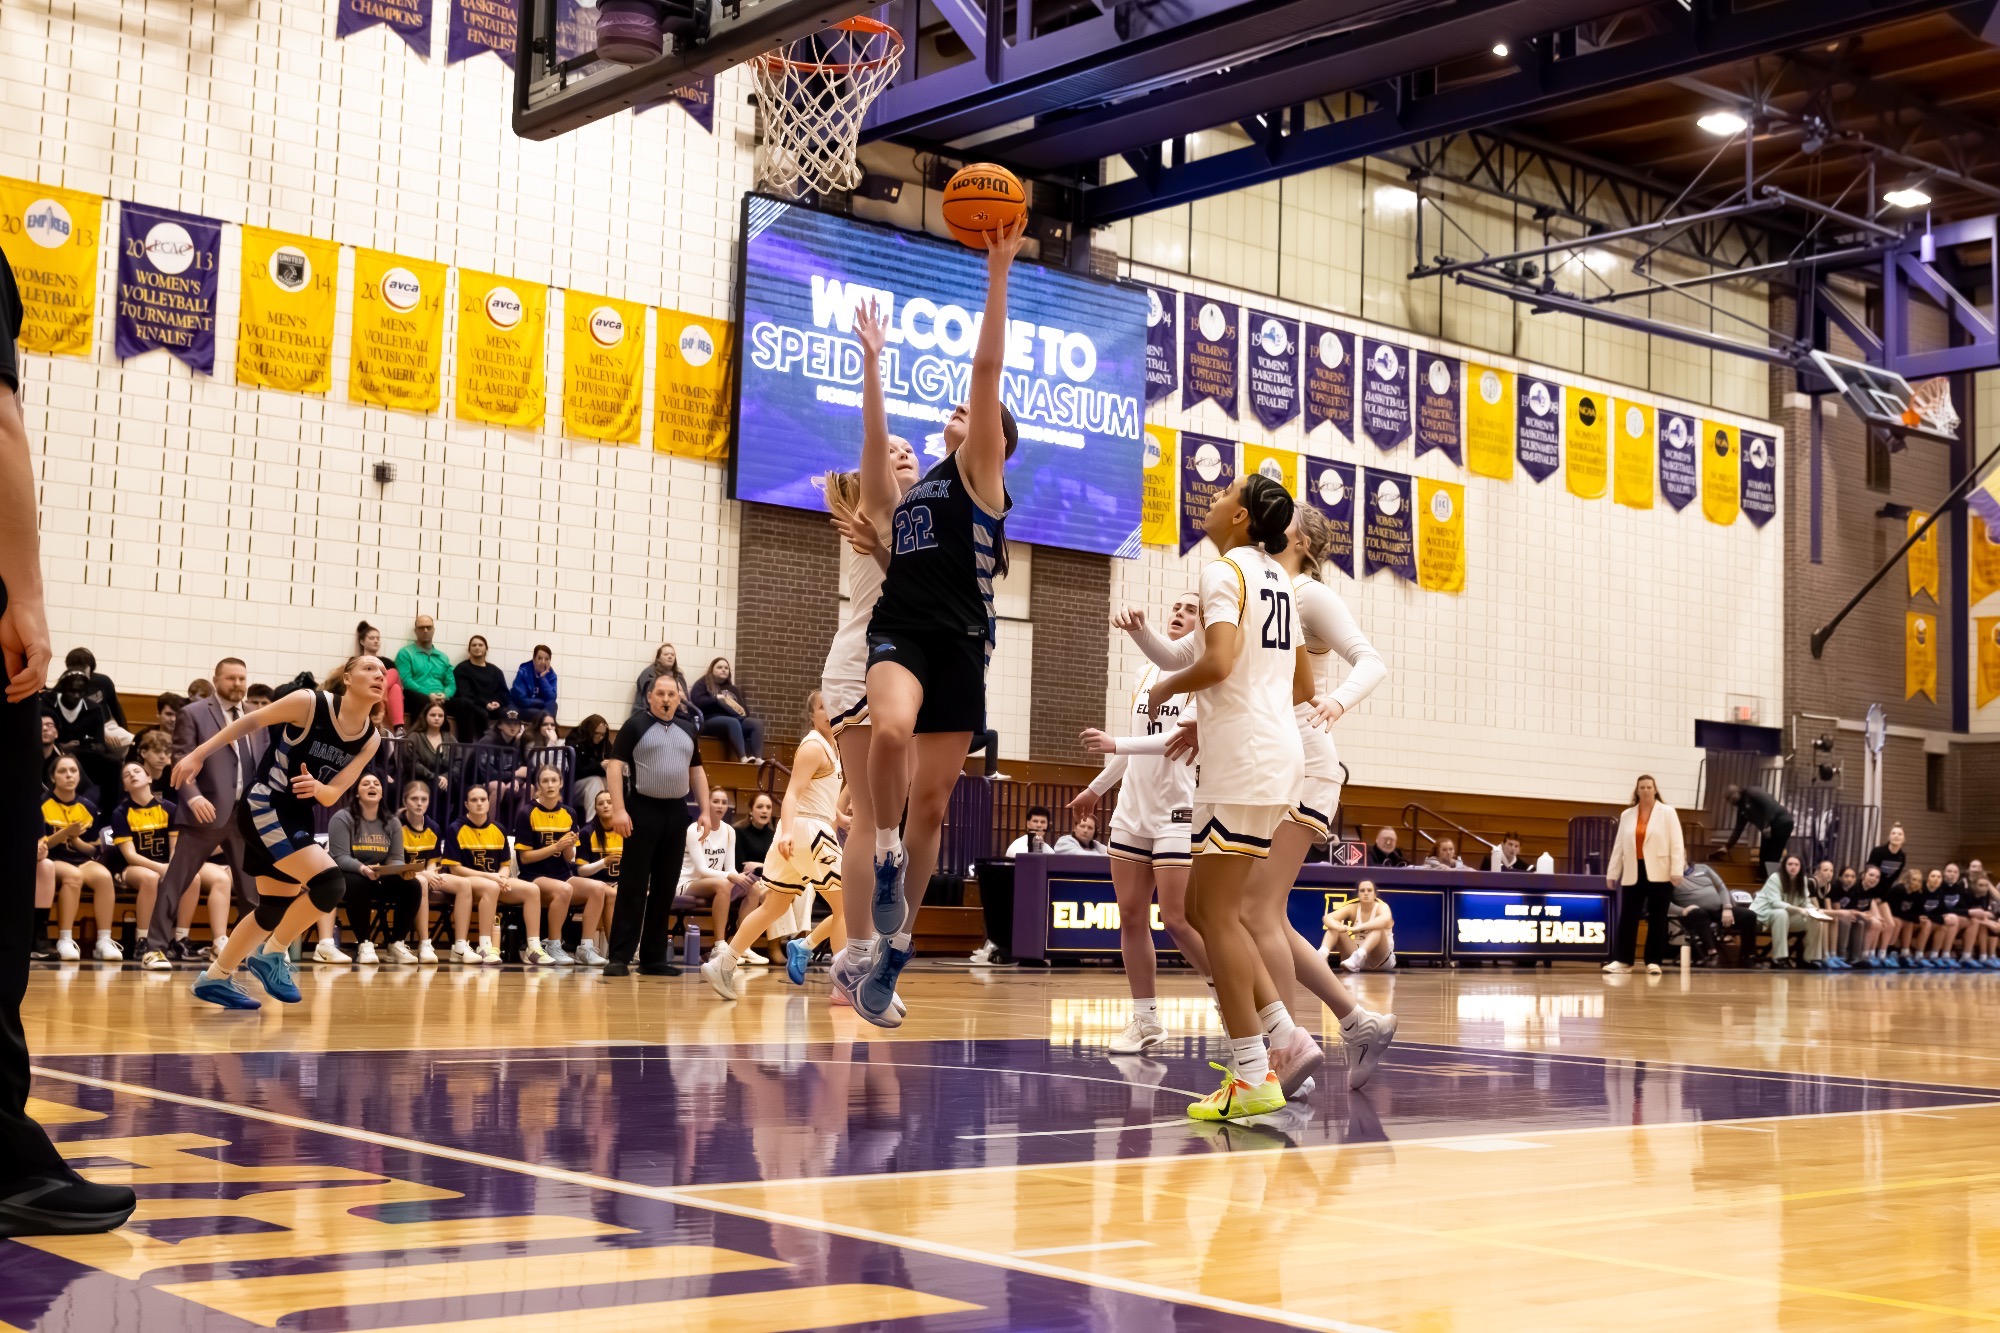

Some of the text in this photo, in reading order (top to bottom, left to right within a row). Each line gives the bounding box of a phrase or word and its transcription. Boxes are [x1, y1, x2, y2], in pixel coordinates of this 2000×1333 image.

[352, 0, 423, 27] CHAMPIONS
[460, 0, 517, 22] BASKETBA
[464, 11, 507, 33] UPSTATE
[467, 29, 516, 52] FINALIST
[952, 176, 1010, 195] Wilson
[76, 228, 94, 247] 13
[126, 238, 145, 258] 20
[195, 251, 213, 271] 13
[136, 269, 200, 294] WOMEN'S
[251, 261, 267, 280] 20
[279, 254, 304, 265] UNITED
[315, 274, 331, 294] 14
[19, 286, 92, 309] LLEYBALL
[122, 284, 210, 312] VOLLEYBALL
[361, 280, 439, 313] 20 avca 14
[23, 305, 91, 327] RNAMENT
[120, 301, 212, 331] TOURNAMENT
[268, 311, 307, 329] MEN'S
[465, 296, 541, 323] 20 avca 15
[136, 324, 194, 347] FINALIST
[381, 317, 417, 333] MEN'S
[571, 316, 640, 343] 20 avca 15
[246, 323, 329, 349] VOLLEYBALL
[364, 329, 429, 352] VOLLEYBALL
[486, 334, 520, 350] MEN'S
[367, 345, 416, 367] DIVISION
[469, 348, 533, 369] VOLLEYBALL
[664, 343, 677, 359] 20
[1038, 325, 1097, 383] TO
[1197, 342, 1230, 358] WOMEN'S
[590, 353, 623, 369] MEN'S
[1190, 354, 1233, 372] BASKETBALL
[1258, 356, 1289, 371] WOMEN'S
[471, 363, 519, 382] DIVISION
[574, 365, 633, 386] VOLLEYBALL
[1146, 370, 1172, 385] AMENT
[576, 381, 622, 400] DIVISION
[671, 382, 720, 400] WOMEN'S
[911, 355, 1140, 440] GYNASIUM
[1190, 380, 1233, 398] CHAMPIONS
[1370, 381, 1401, 395] WOMEN'S
[1257, 394, 1289, 410] FINALIST
[1372, 417, 1400, 432] FINALIST
[1525, 417, 1554, 431] WOMEN'S
[673, 430, 716, 447] FINALIST
[1143, 475, 1166, 486] MEN'S
[1143, 499, 1171, 512] NAMENT
[895, 505, 938, 555] 22
[1376, 514, 1403, 528] WOMEN'S
[1368, 525, 1410, 541] BASKETBALL
[1366, 537, 1412, 553] TOURNAMENT
[1260, 589, 1291, 650] 20
[1136, 703, 1180, 717] ELIRA
[309, 740, 355, 767] HARTW
[1052, 901, 1121, 930] ELMI
[1540, 921, 1606, 944] EAGLES
